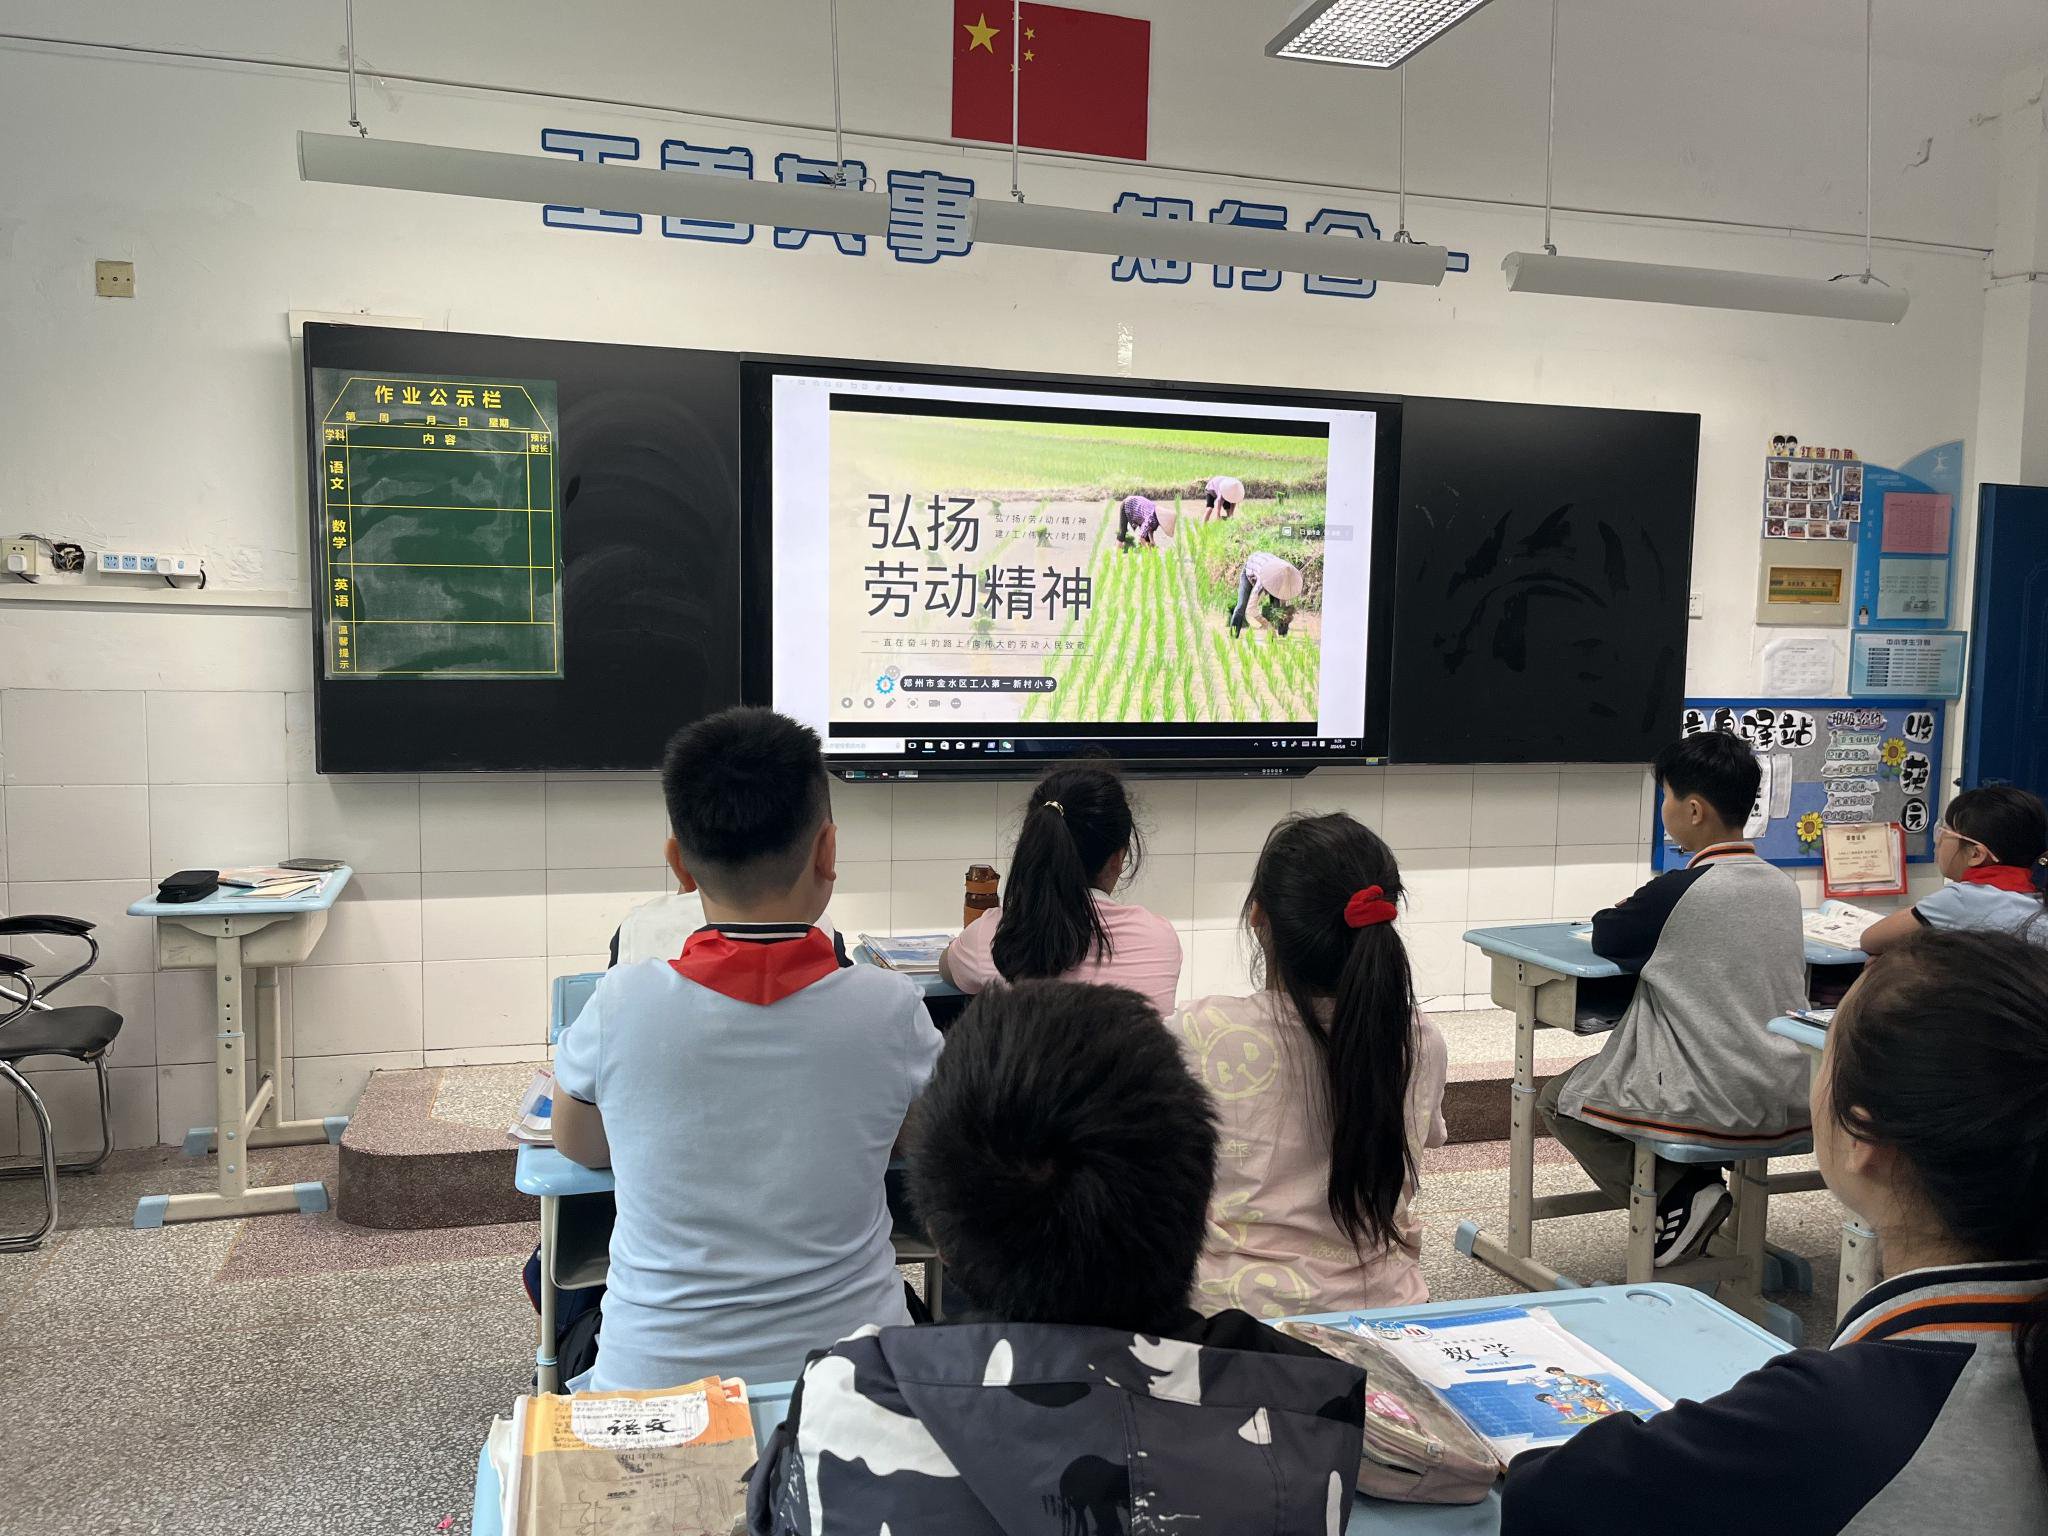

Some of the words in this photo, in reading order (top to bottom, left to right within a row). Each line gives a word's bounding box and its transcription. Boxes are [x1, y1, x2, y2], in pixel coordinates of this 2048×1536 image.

[375, 385, 502, 409] 作业公示栏
[345, 411, 356, 422] 第
[379, 412, 389, 423] 周
[426, 415, 436, 426] 月
[458, 416, 468, 428] 日
[489, 417, 510, 429] 星期
[325, 428, 346, 441] 学科
[530, 433, 549, 443] 预计
[530, 444, 548, 454] 时长
[329, 460, 345, 492] 语文
[332, 519, 347, 550] 数学
[867, 493, 980, 552] 弘扬
[334, 578, 349, 609] 英语
[864, 561, 1093, 621] 劳动精神
[338, 625, 350, 670] 温馨提示
[903, 677, 1054, 690] 郑州市金水区工人第一新村小学
[1441, 1344, 1515, 1362] 数学
